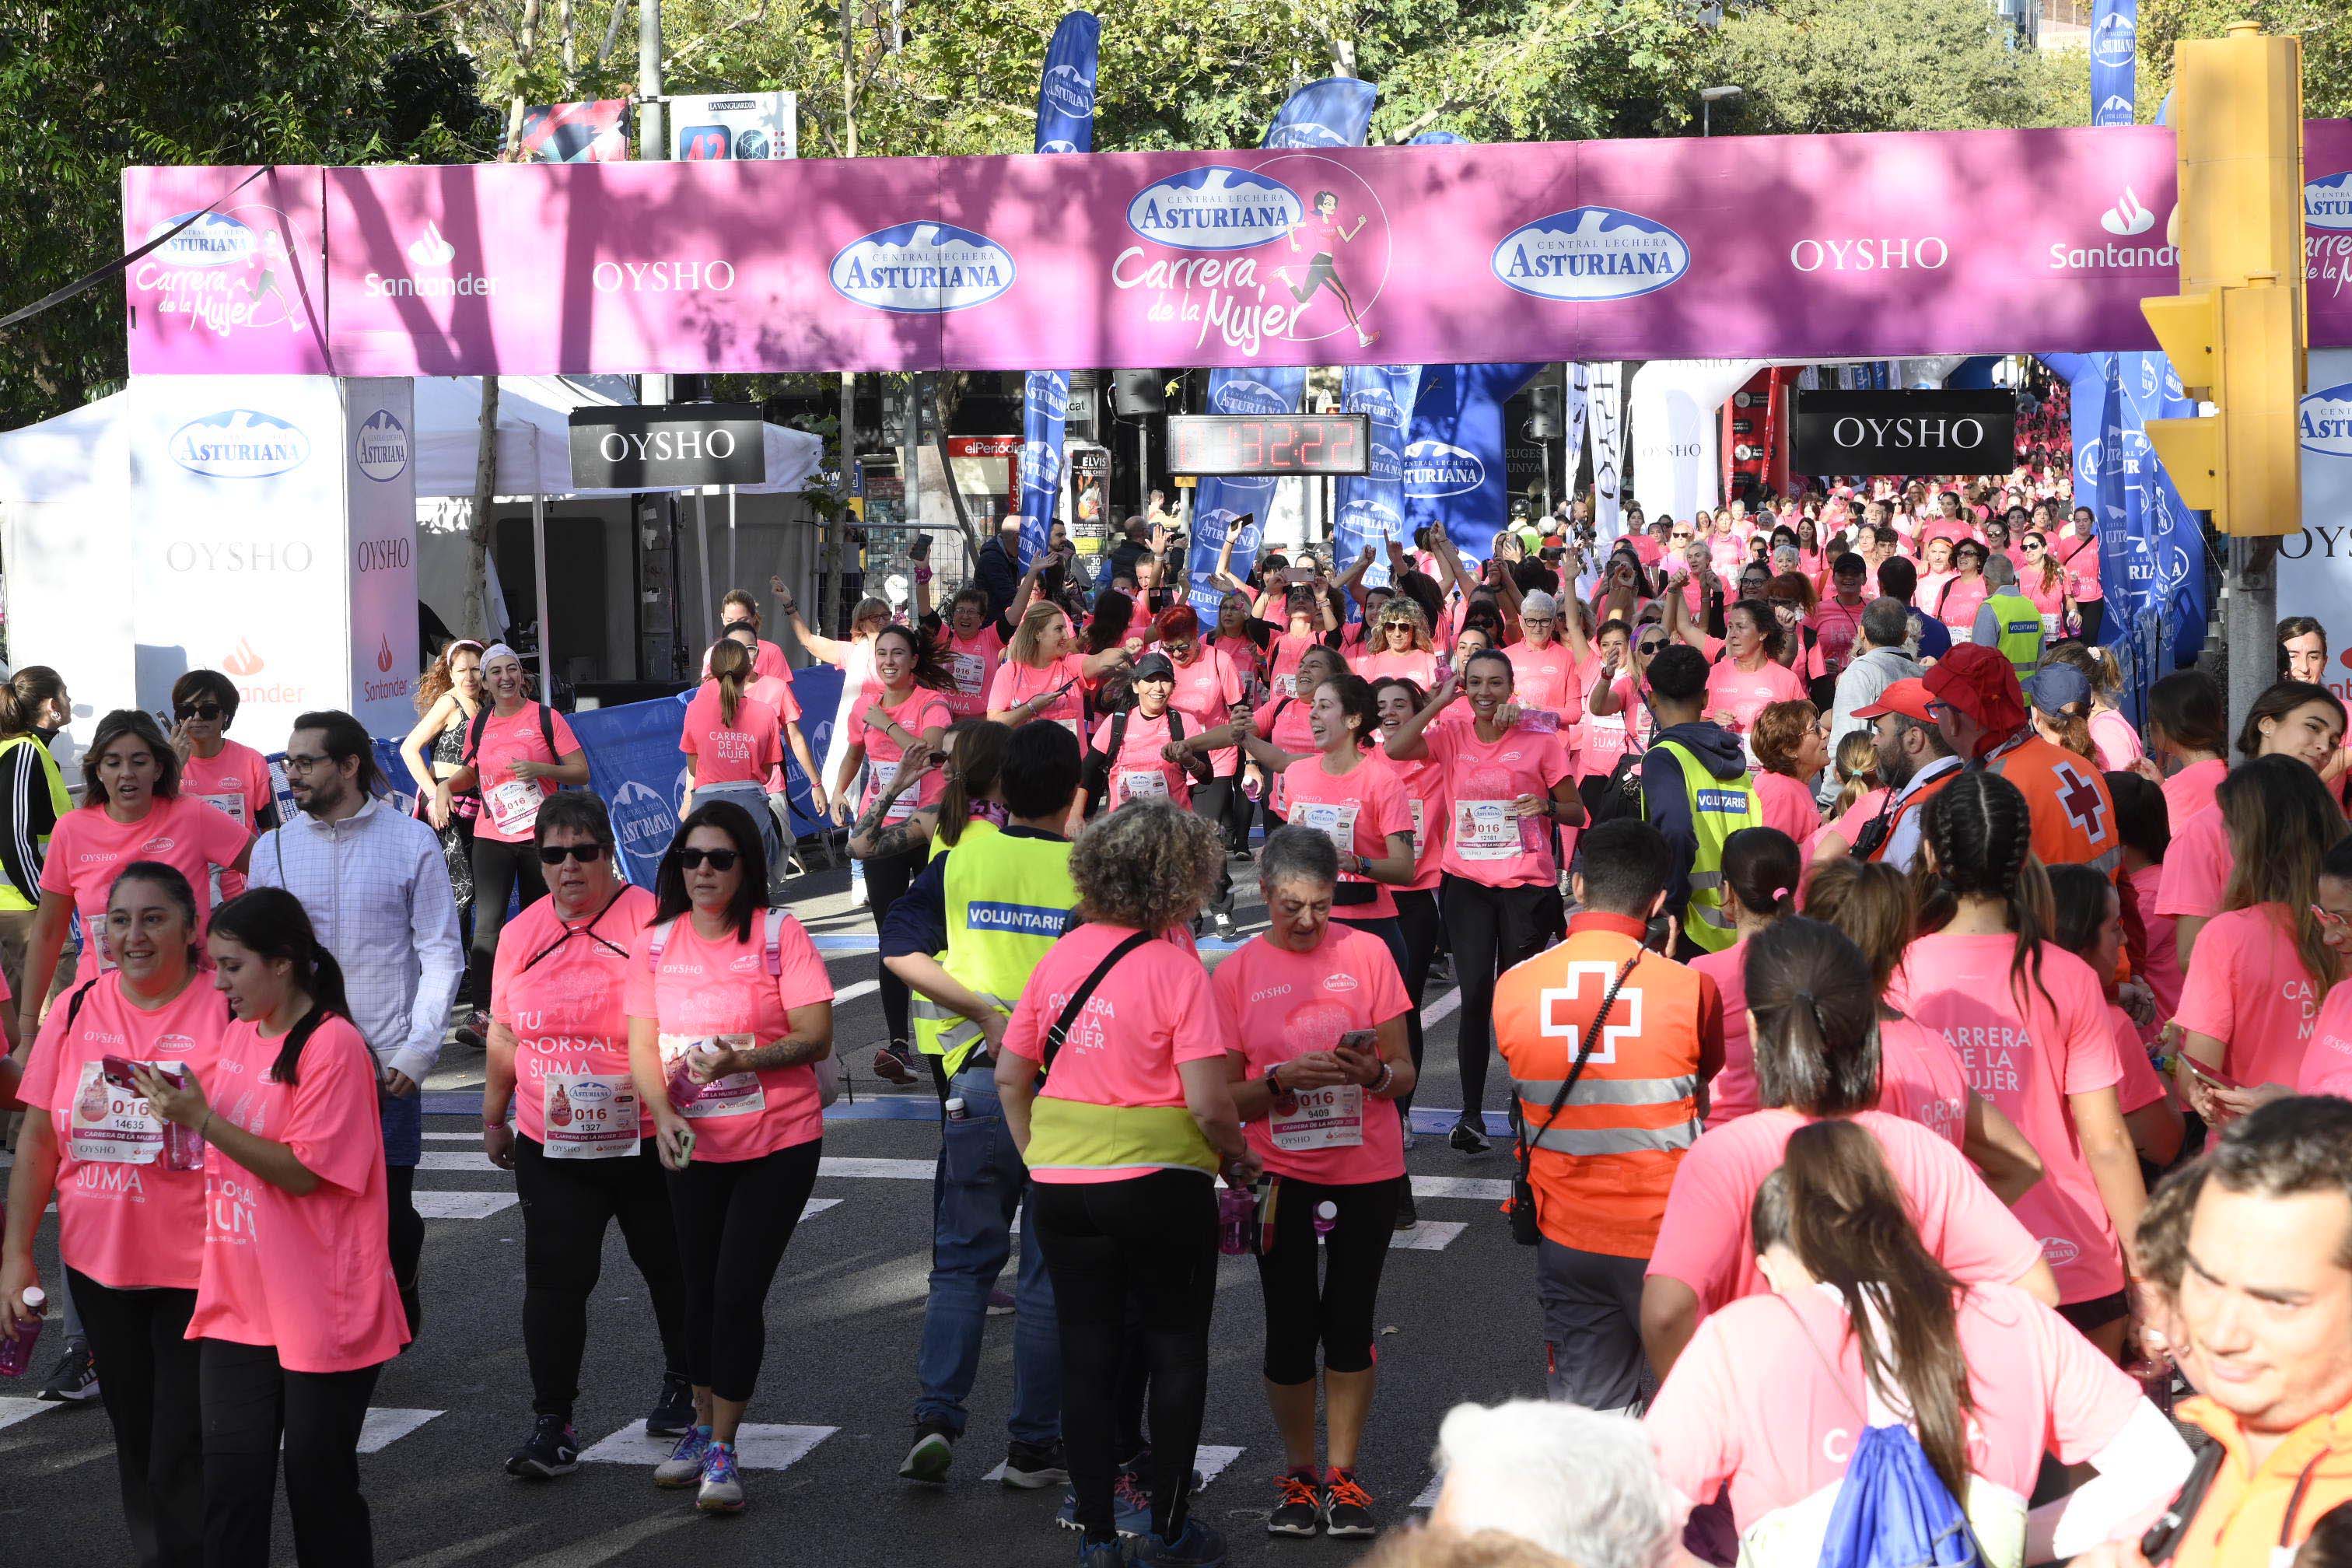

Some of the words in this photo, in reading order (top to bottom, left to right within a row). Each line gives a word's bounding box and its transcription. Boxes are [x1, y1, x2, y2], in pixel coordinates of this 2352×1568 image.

[1167, 194, 1224, 205] CENTRAL
[1228, 193, 1285, 203] LECHERA
[1139, 197, 1290, 229] ASTURIANA
[1537, 239, 1599, 250] CENTRAL
[1605, 238, 1668, 248] LECHERA
[873, 253, 932, 262] CENTRAL
[936, 252, 996, 261] LECHERA
[1507, 243, 1675, 278] ASTURIANA
[1790, 236, 1949, 271] OYSHO
[136, 261, 229, 292] Carrera
[592, 259, 735, 293] OYSHO
[843, 261, 1002, 290] ASTURIANA
[1112, 246, 1259, 289] Carrera
[2322, 257, 2337, 279] la
[365, 272, 499, 297] Santander
[159, 297, 176, 314] de
[177, 296, 191, 313] la
[190, 289, 261, 336] Mujer
[1147, 301, 1174, 322] de
[1181, 297, 1200, 322] la
[1196, 283, 1312, 357] Mujer
[1832, 417, 1984, 449] OYSHO
[180, 435, 299, 461] ASTURIANA
[359, 440, 405, 464] ASTURIANA
[600, 429, 736, 464] OYSHO
[1082, 457, 1107, 467] ELVIS
[166, 541, 313, 573] OYSHO
[358, 537, 410, 572] OYSHO
[1090, 557, 1101, 565] 30
[364, 676, 408, 703] Santander
[709, 732, 756, 743] CARRERA
[718, 741, 733, 751] DE
[734, 742, 747, 751] LA
[717, 750, 751, 759] MUJER
[481, 775, 494, 786] TU
[507, 797, 526, 810] 016
[1478, 824, 1500, 833] 016
[81, 853, 117, 863] OYSHO
[663, 964, 704, 975] OYSHO
[1251, 983, 1293, 1003] OYSHO
[518, 1010, 543, 1031] TU
[1080, 1017, 1102, 1031] LA
[1985, 1048, 2014, 1069] LA
[572, 1089, 609, 1097] ASTURIANA
[1300, 1091, 1334, 1107] 016
[112, 1100, 150, 1116] 016
[575, 1108, 607, 1121] 016
[1307, 1109, 1329, 1118] 9409
[115, 1118, 145, 1129] 14635
[79, 1144, 116, 1155] OYSHO
[1281, 1136, 1311, 1145] OYSHO
[77, 1165, 144, 1194] SUMA
